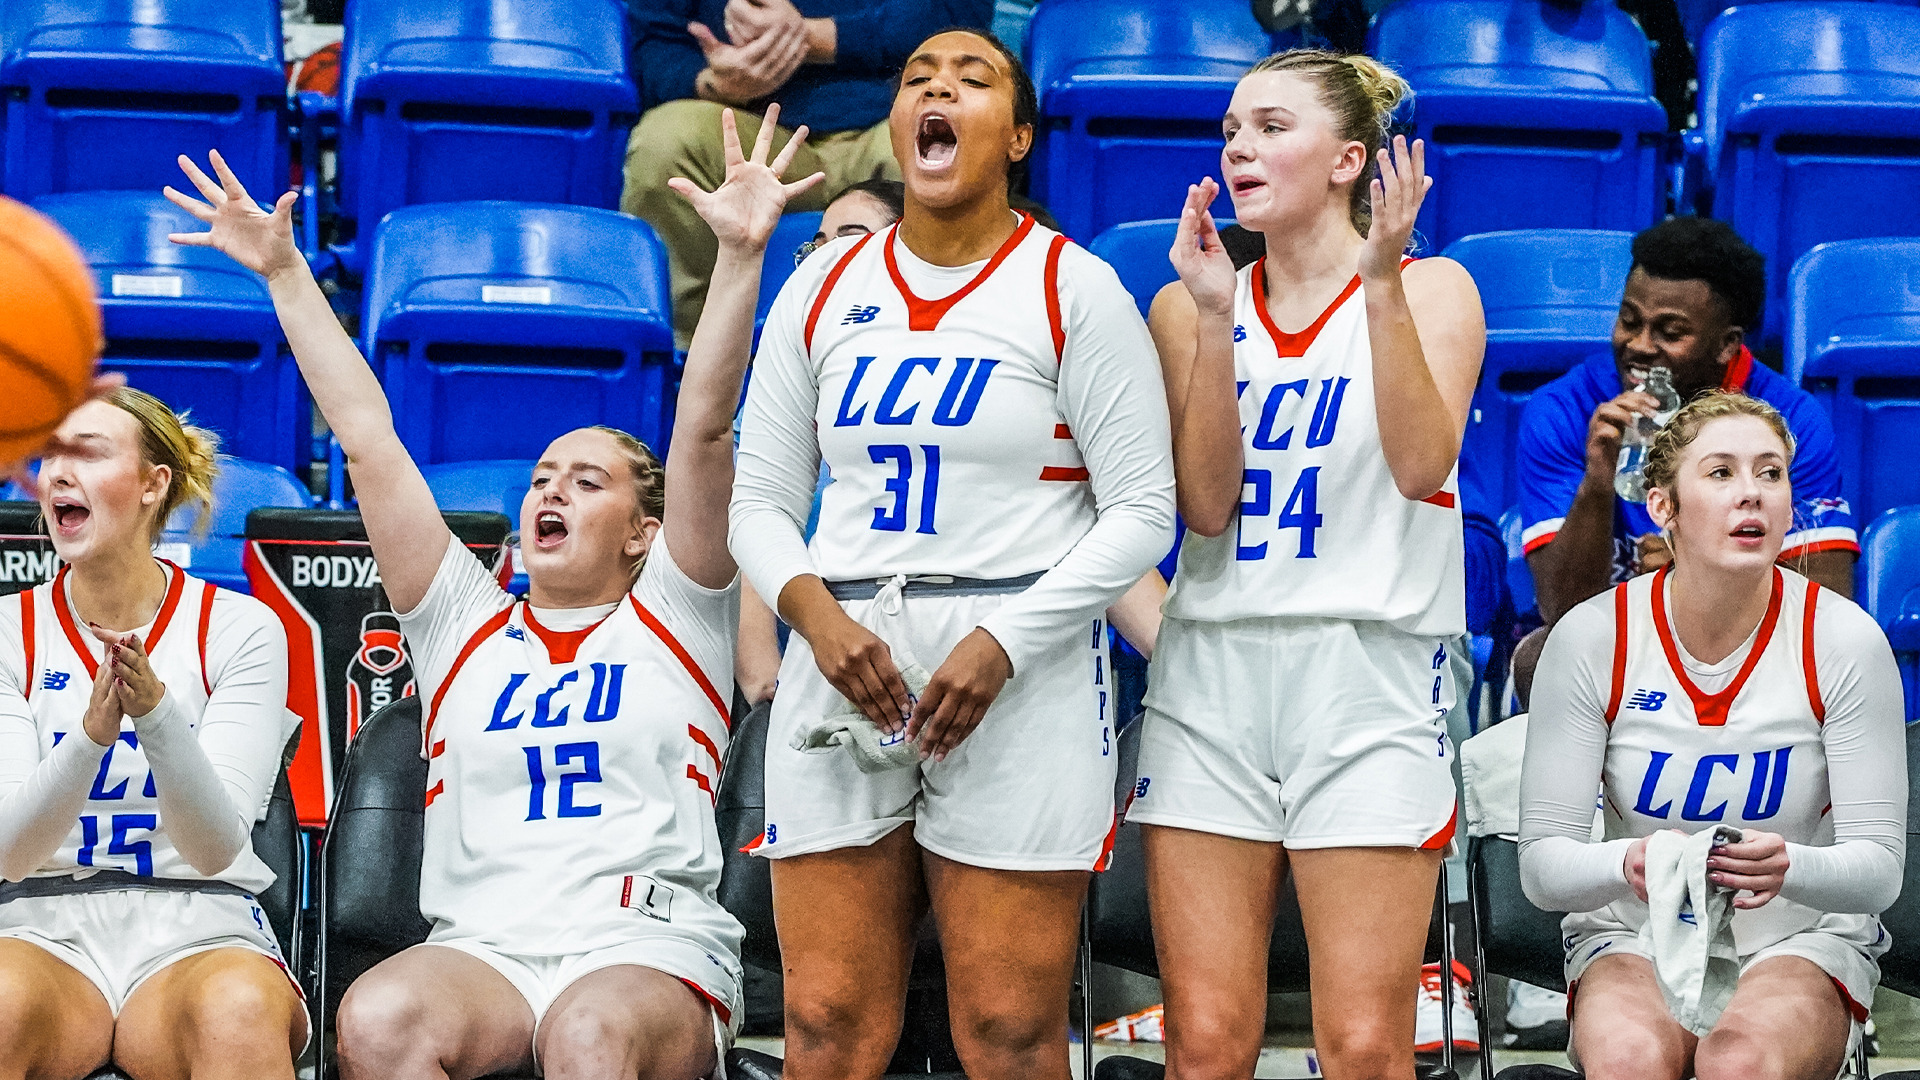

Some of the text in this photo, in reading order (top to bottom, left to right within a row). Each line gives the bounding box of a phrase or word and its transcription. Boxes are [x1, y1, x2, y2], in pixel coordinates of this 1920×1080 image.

[834, 356, 1001, 427] LCU
[867, 444, 940, 534] 31
[1236, 466, 1323, 561] 24
[483, 662, 628, 732] LCU
[521, 741, 603, 822] 12
[1633, 745, 1795, 821] LCU
[77, 814, 156, 877] 15
[646, 884, 655, 909] L
